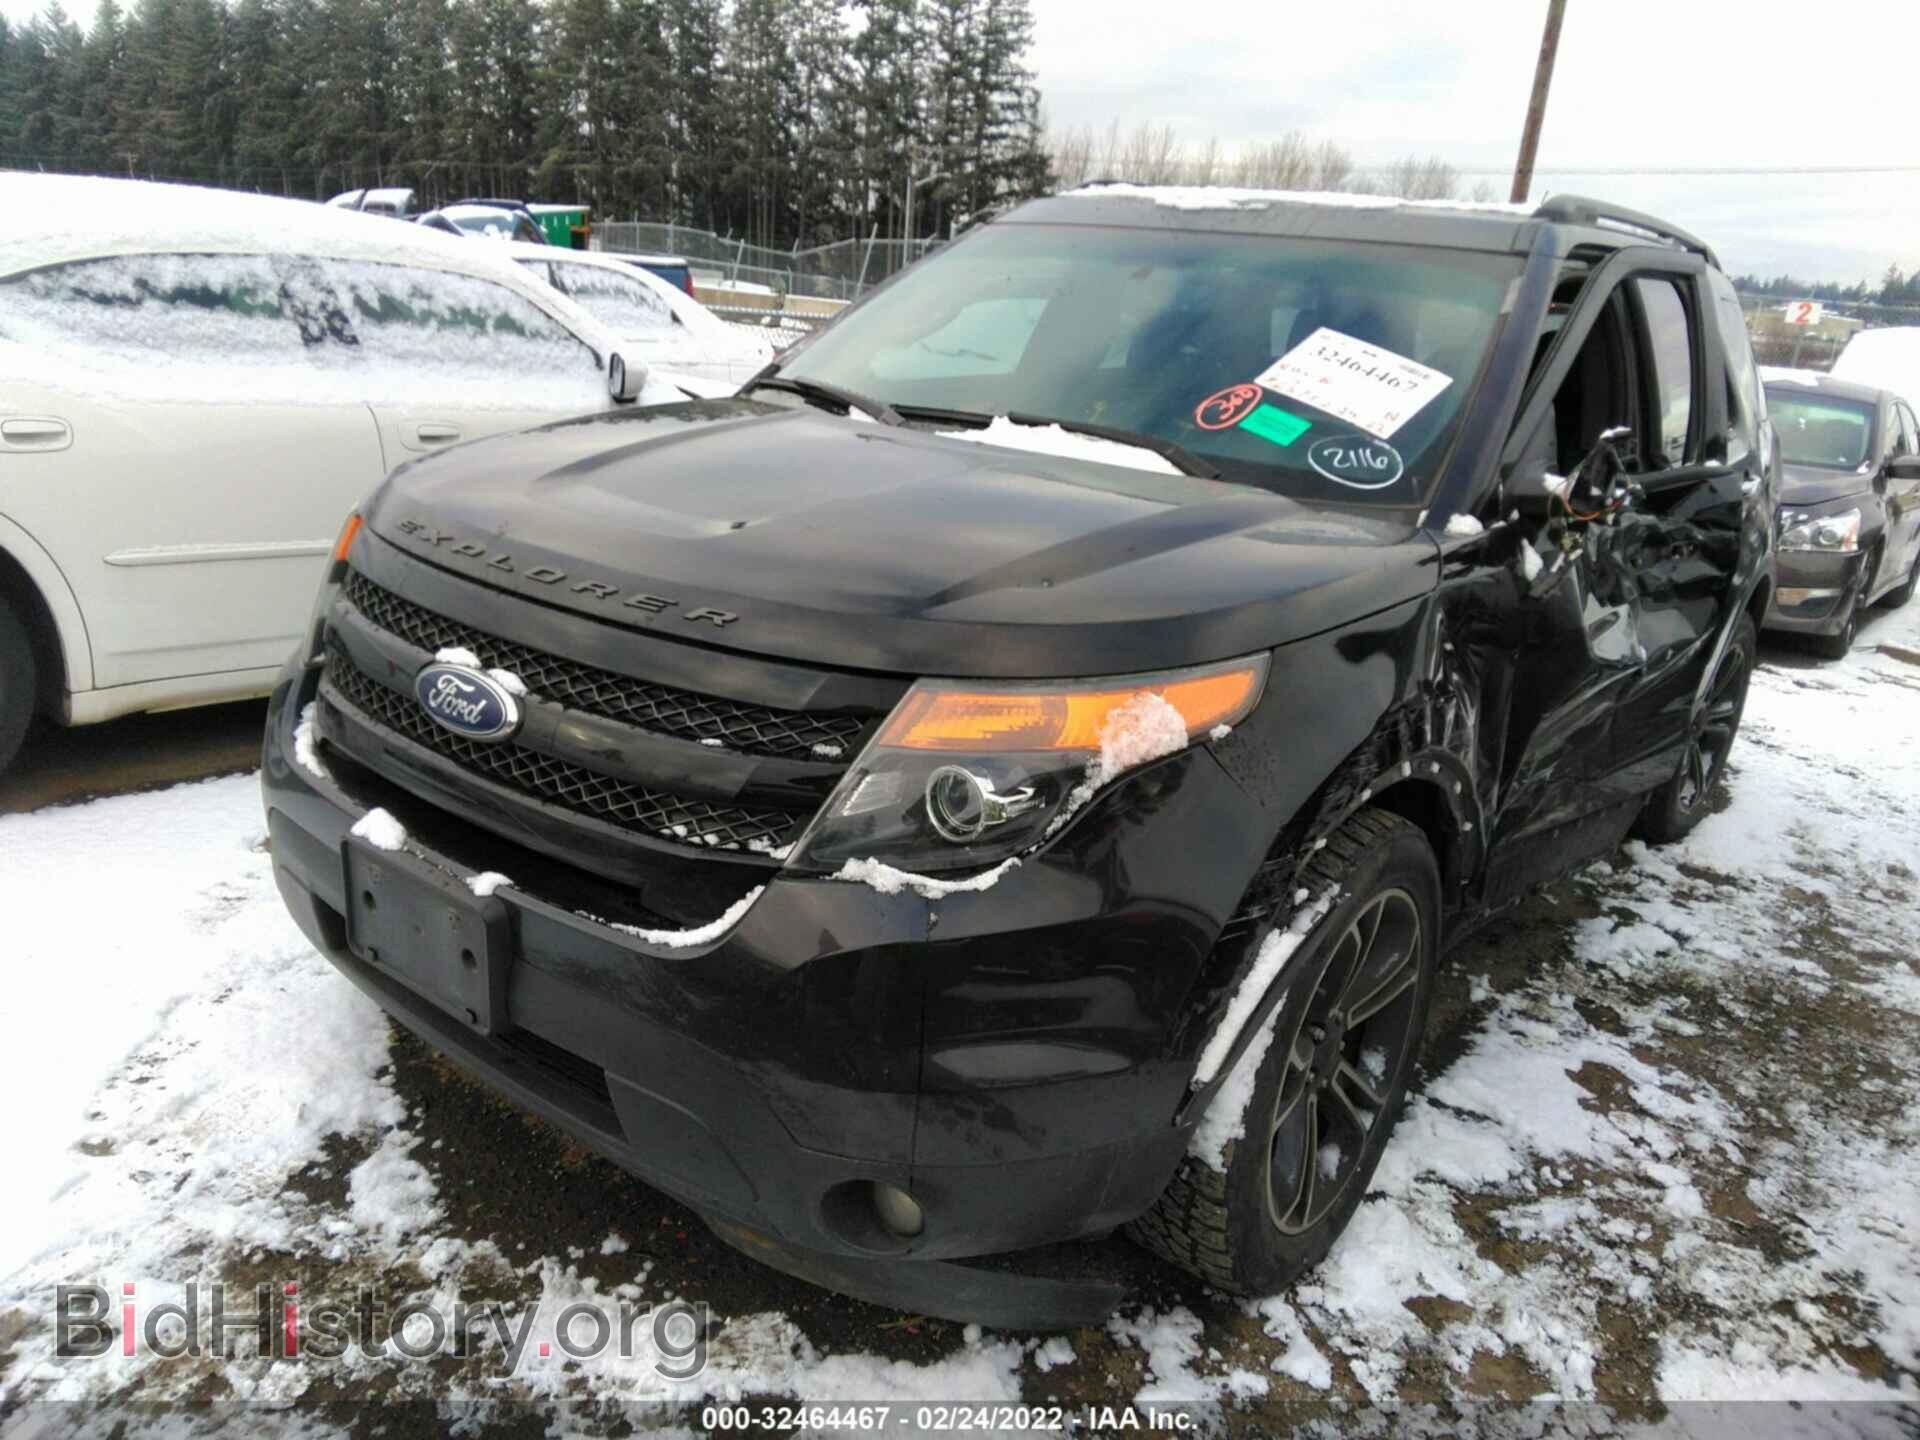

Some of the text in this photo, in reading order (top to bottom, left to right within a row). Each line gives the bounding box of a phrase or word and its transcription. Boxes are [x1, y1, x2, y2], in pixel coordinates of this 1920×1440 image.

[1795, 303, 1813, 325] 2
[1323, 447, 1389, 469] 2116
[398, 519, 740, 627] EXPLORER
[427, 673, 487, 725] Ford
